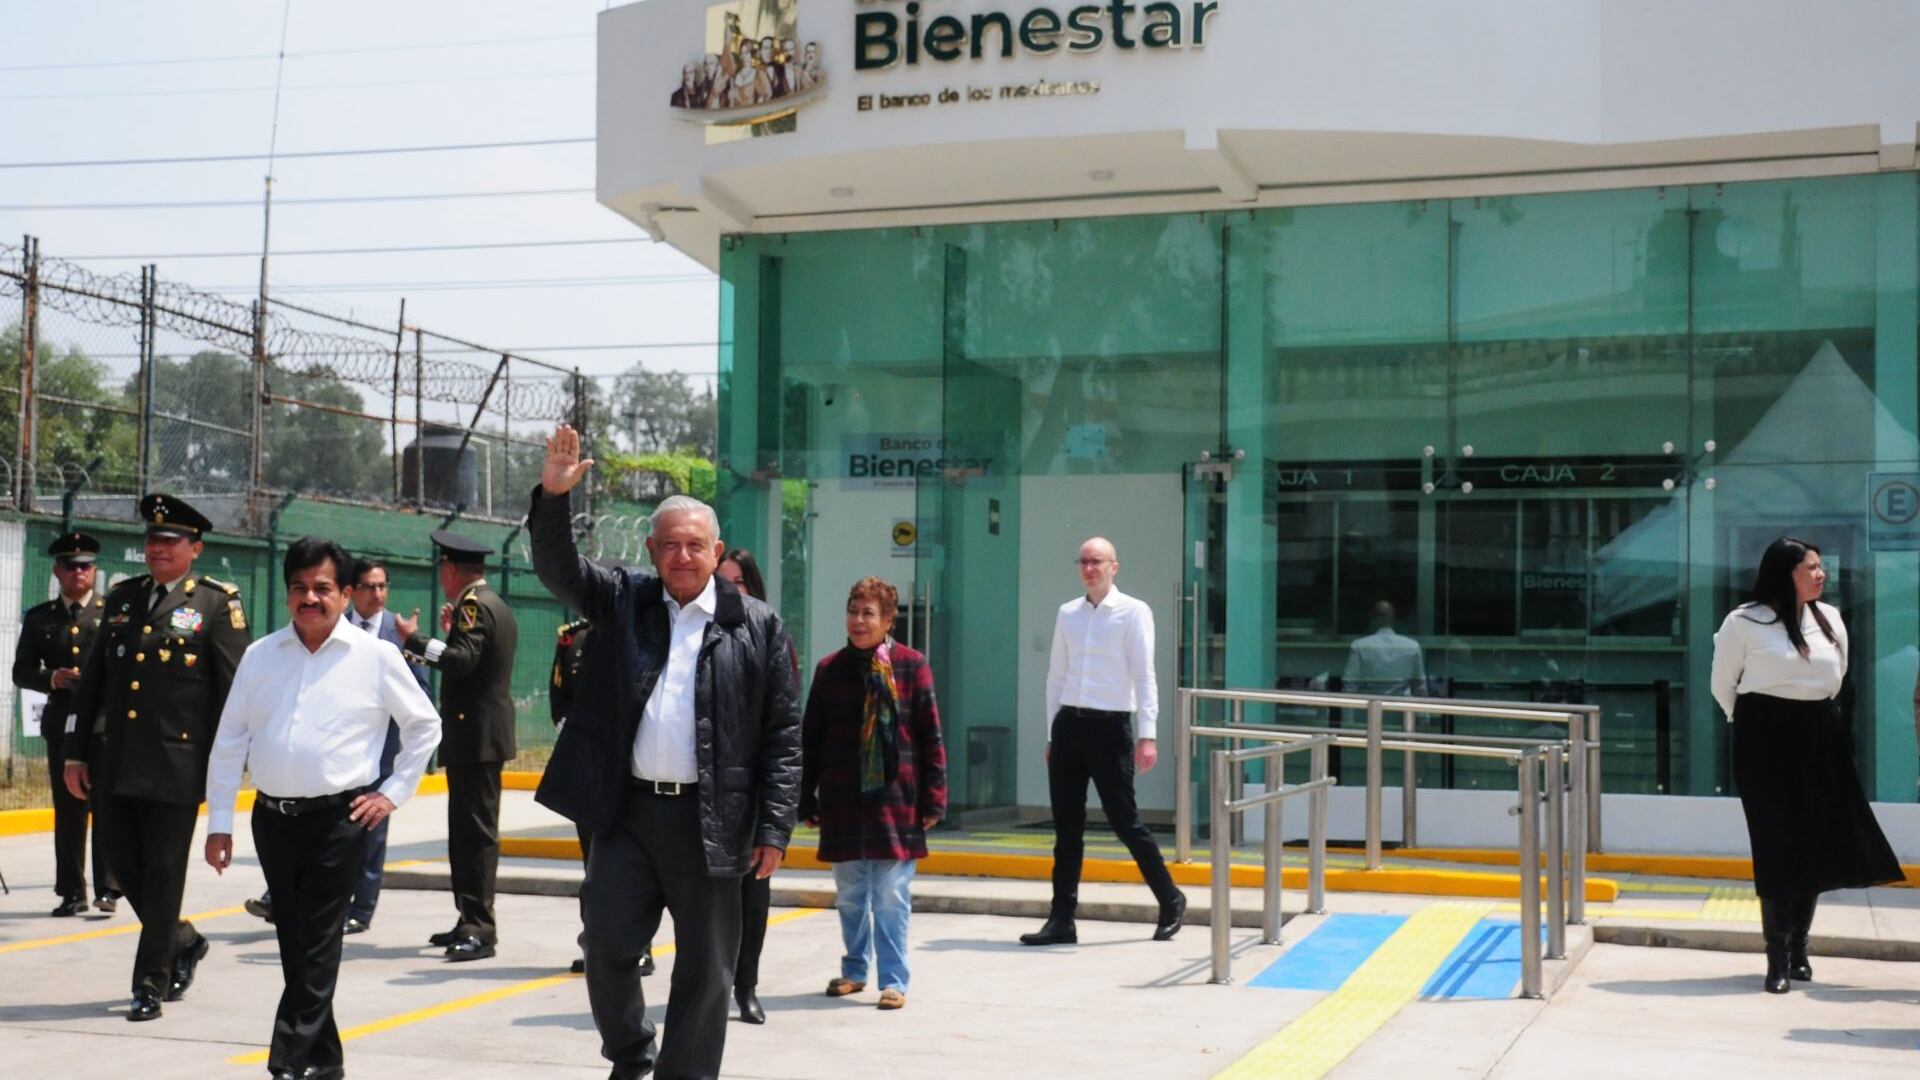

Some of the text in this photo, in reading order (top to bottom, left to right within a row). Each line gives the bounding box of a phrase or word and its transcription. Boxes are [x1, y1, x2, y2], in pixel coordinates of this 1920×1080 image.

[854, 0, 1219, 71] Bienestar
[857, 95, 873, 111] El
[880, 91, 931, 109] banco
[938, 87, 960, 104] de
[880, 438, 932, 451] Banco
[1501, 463, 1616, 482] CAJA 2
[1887, 488, 1907, 516] E
